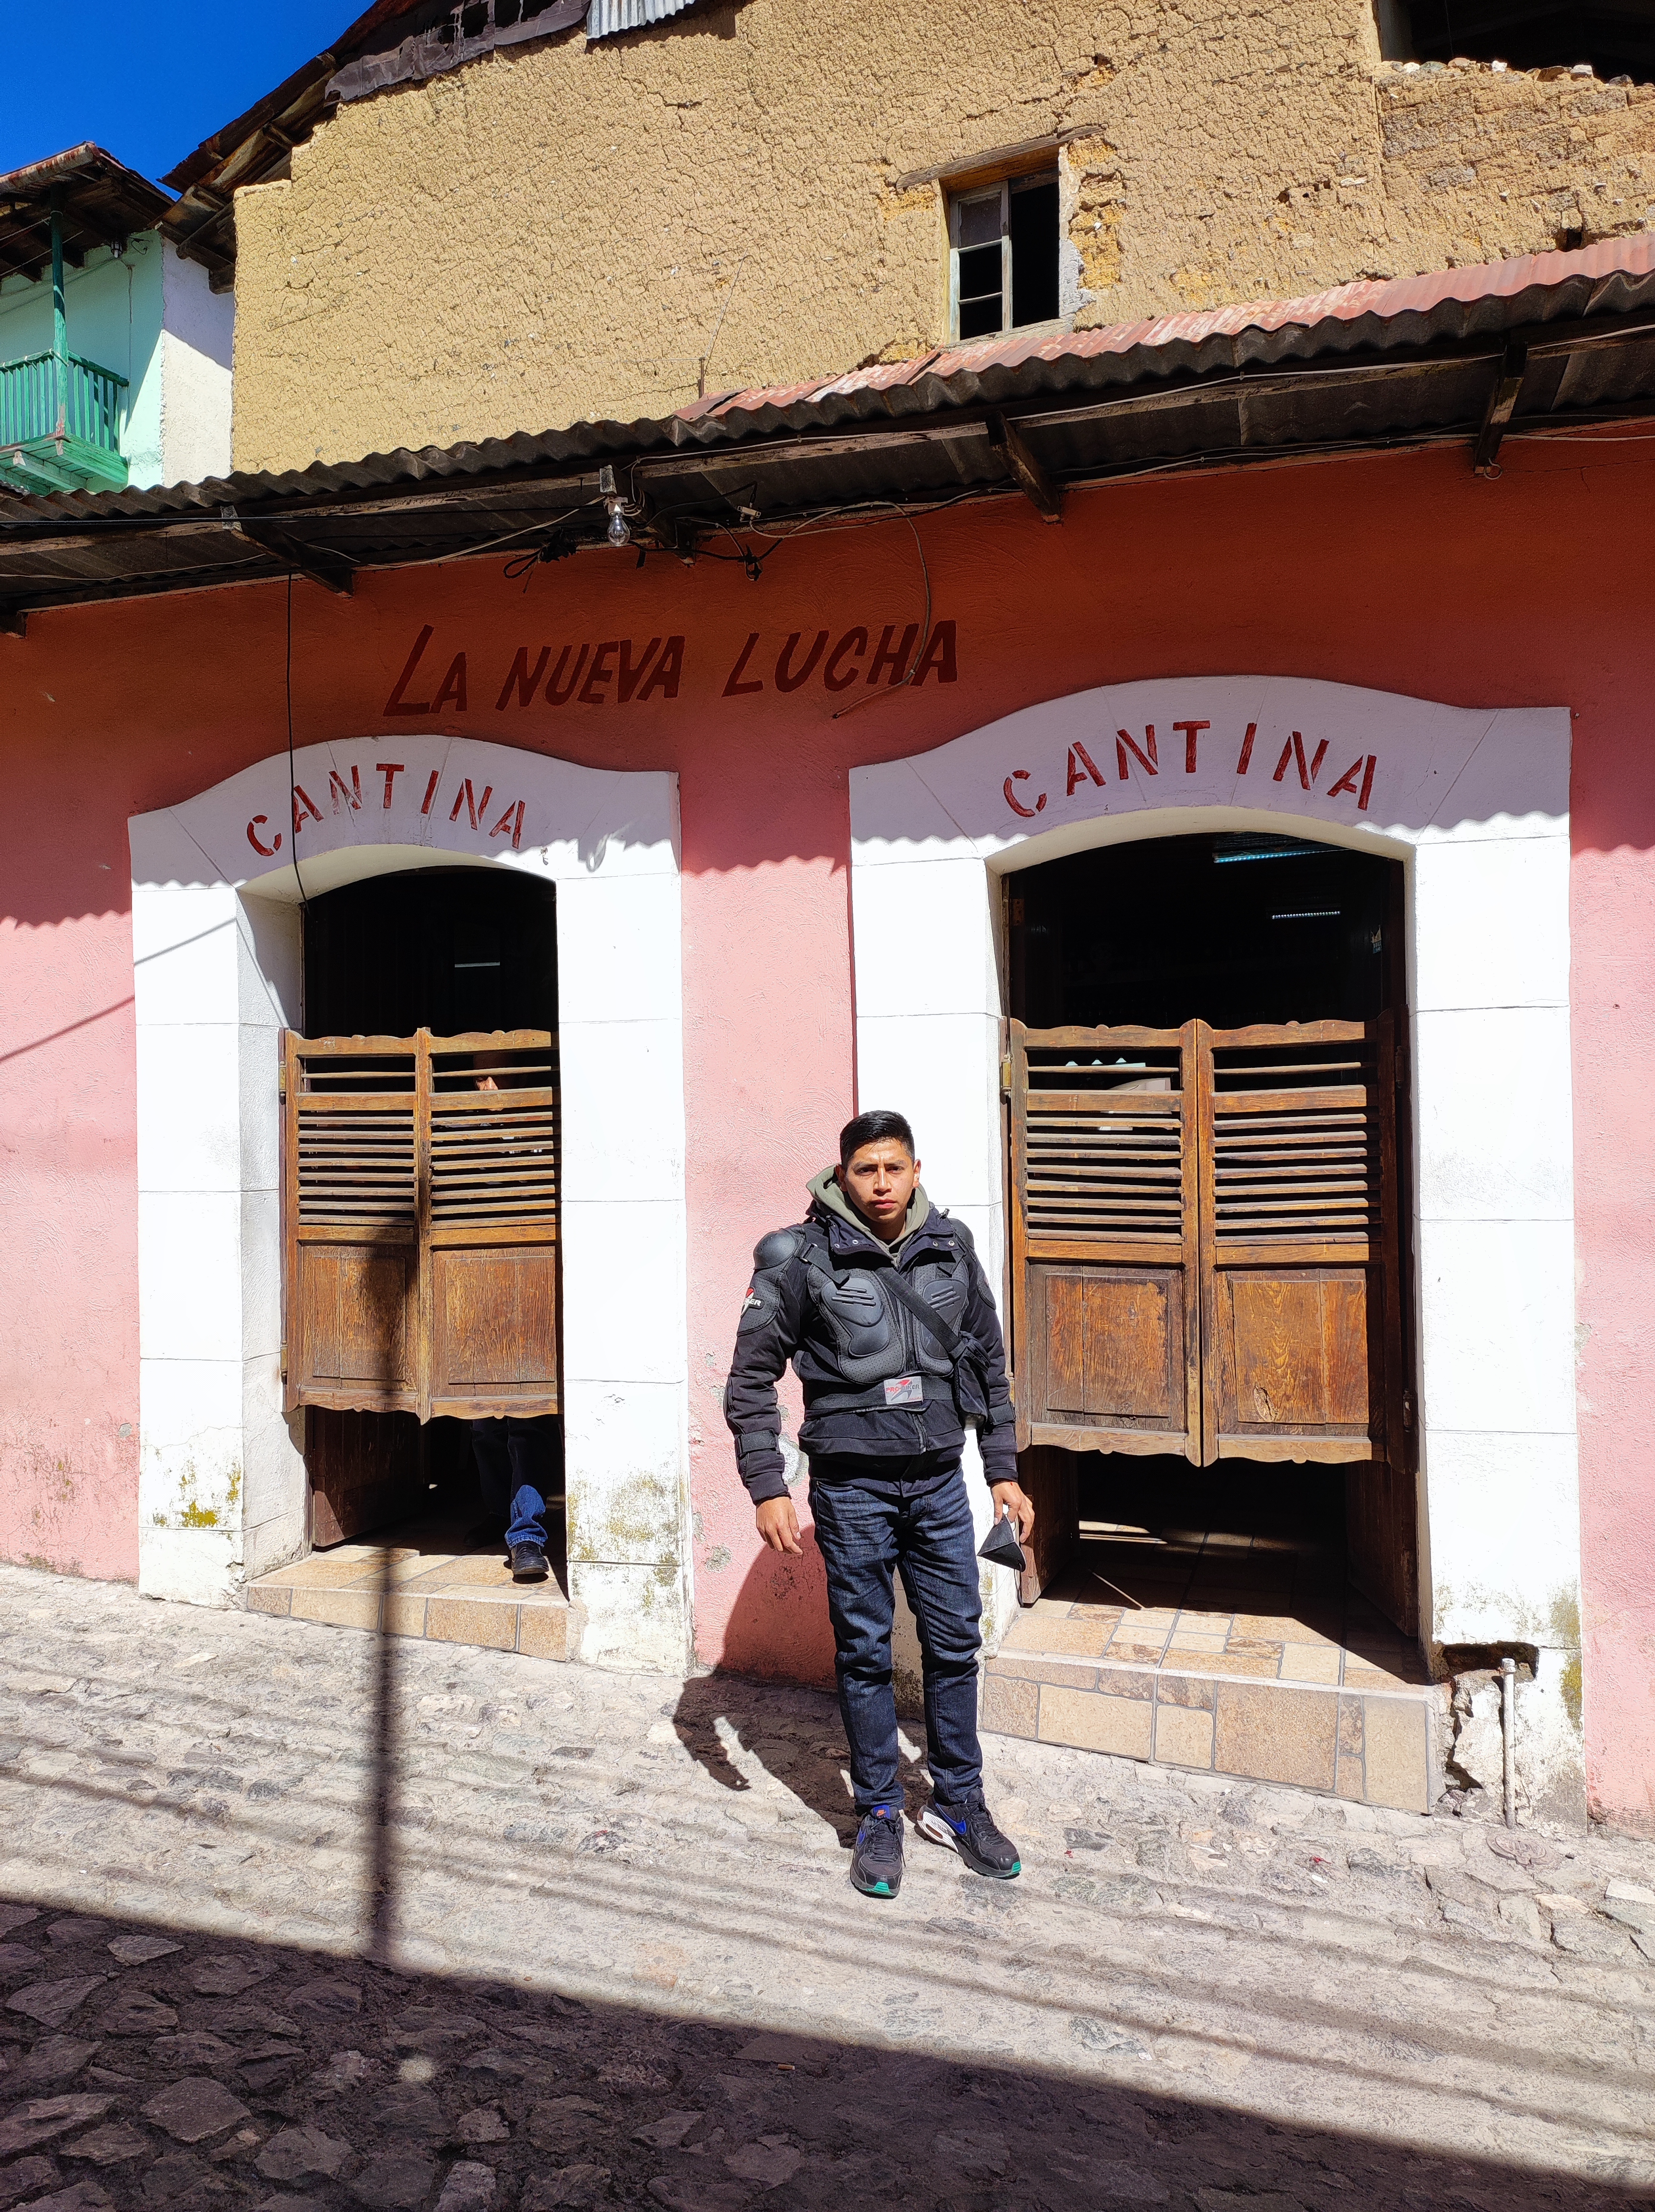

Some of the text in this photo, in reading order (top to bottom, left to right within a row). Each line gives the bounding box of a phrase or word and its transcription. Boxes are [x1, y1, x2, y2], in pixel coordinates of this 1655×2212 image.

[383, 620, 957, 716] LA NUEVA LUCHA
[246, 763, 526, 857] CANTINA
[1003, 720, 1377, 818] CANTINA
